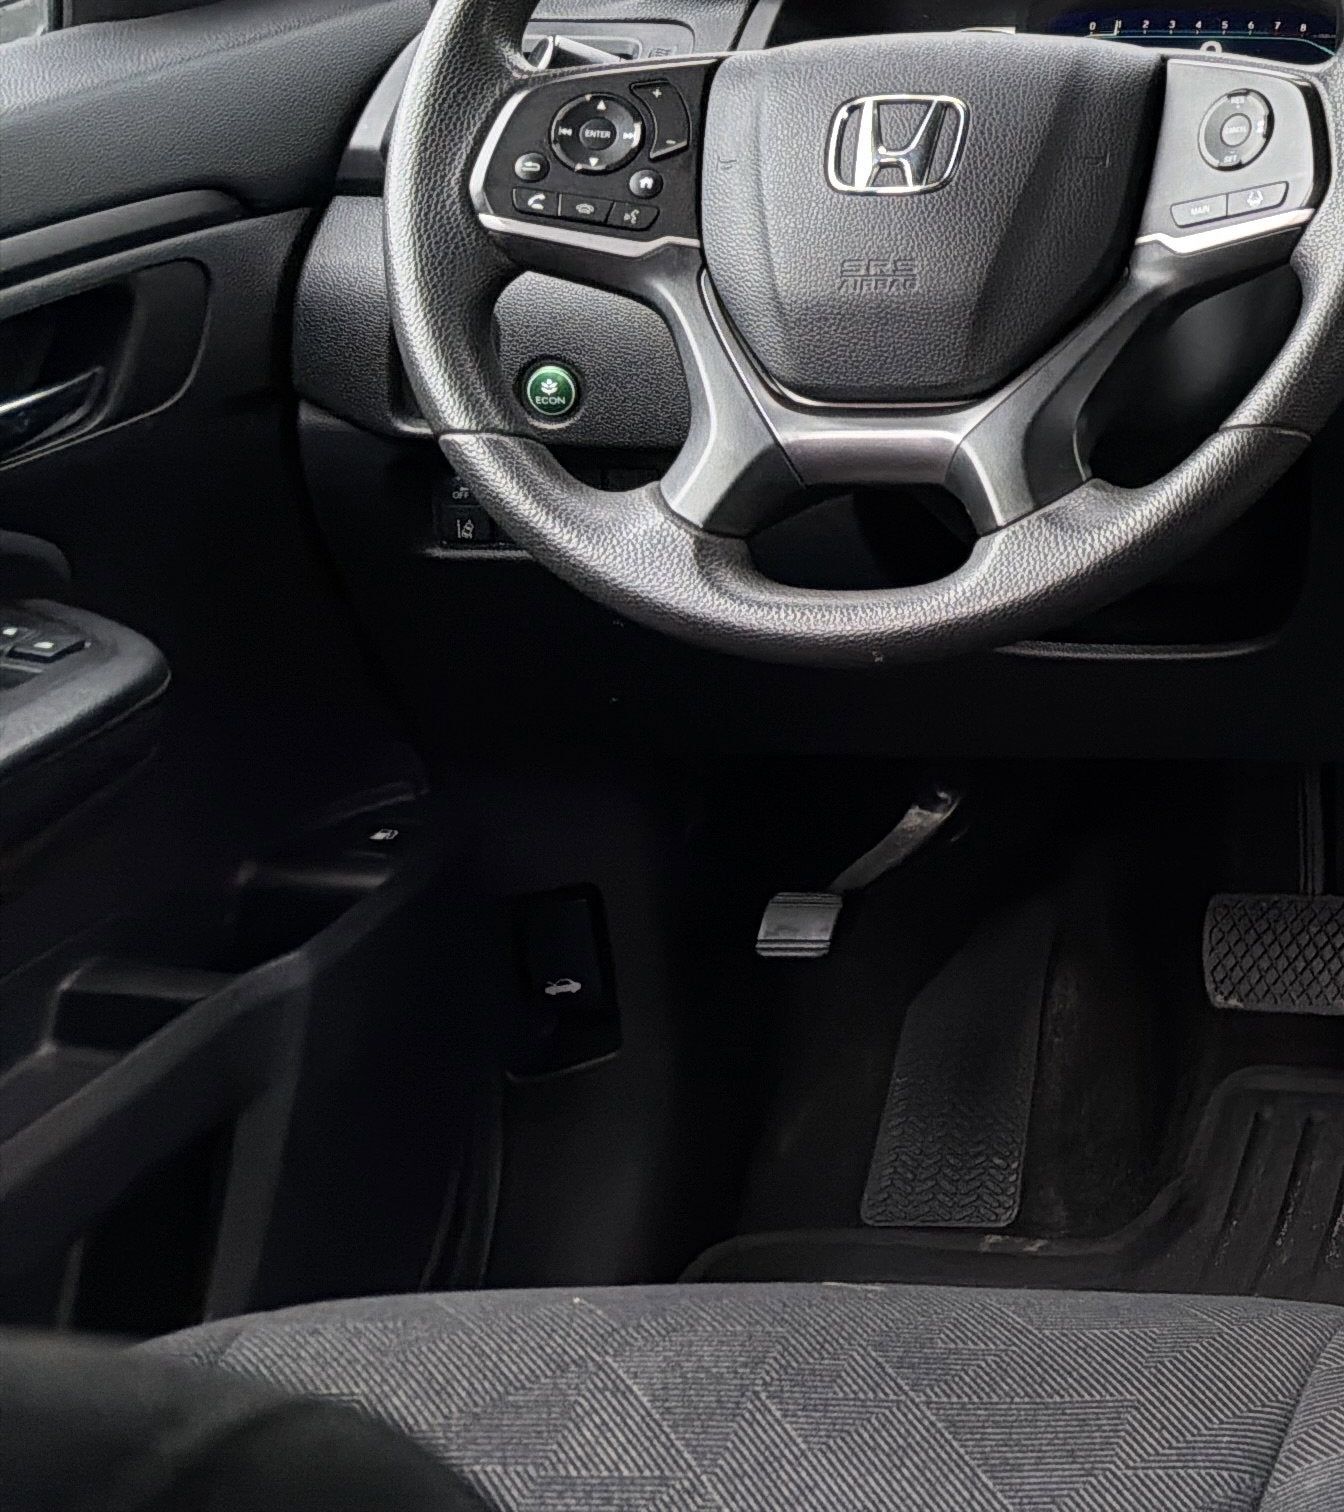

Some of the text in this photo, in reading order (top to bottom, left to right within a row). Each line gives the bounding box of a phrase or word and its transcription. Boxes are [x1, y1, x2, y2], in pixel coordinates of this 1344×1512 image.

[1090, 22, 1096, 31] 0
[1143, 20, 1149, 29] 2
[1169, 20, 1176, 29] 3
[1196, 20, 1202, 29] 4
[1222, 20, 1228, 30] 5
[1248, 21, 1255, 30] 6
[1275, 21, 1281, 30] 7
[1300, 23, 1307, 32] 8
[584, 128, 612, 139] ENTER
[1191, 205, 1210, 216] MAIN
[535, 396, 566, 406] ECON
[451, 491, 471, 499] OFF
